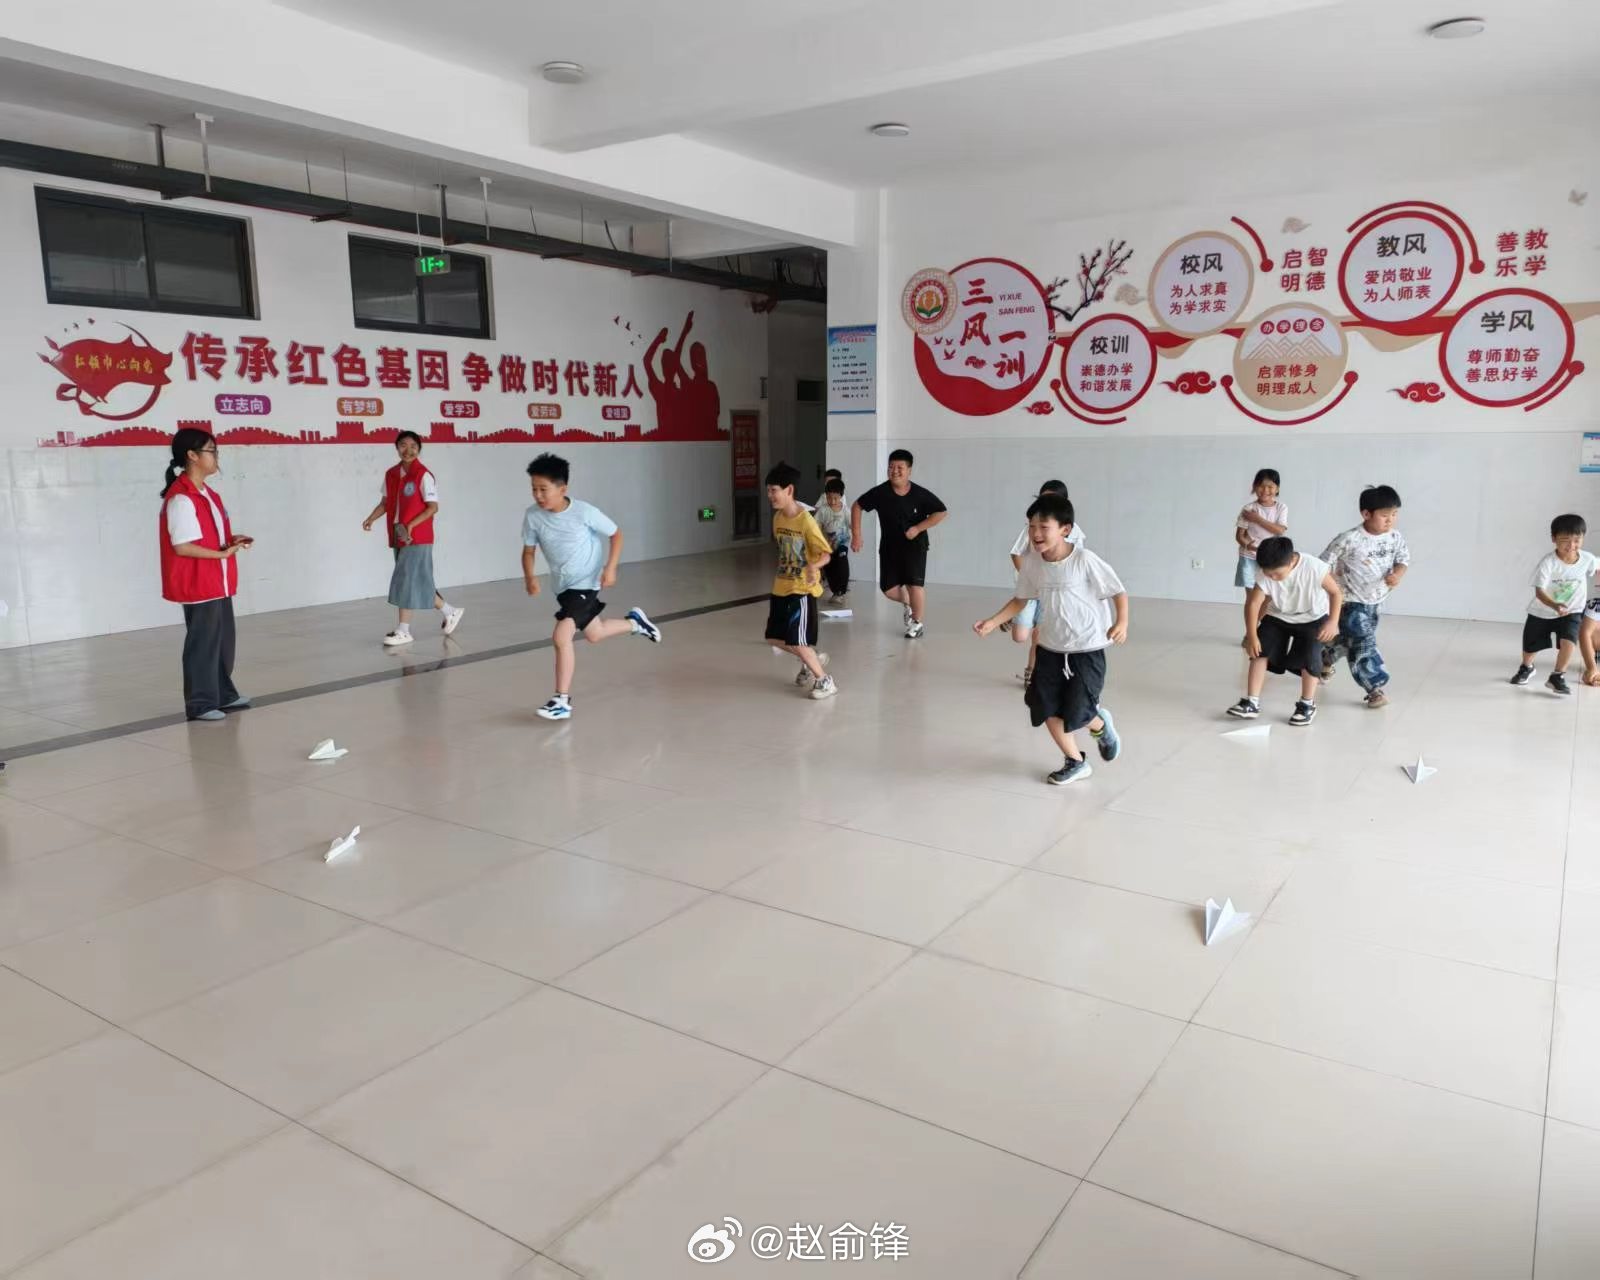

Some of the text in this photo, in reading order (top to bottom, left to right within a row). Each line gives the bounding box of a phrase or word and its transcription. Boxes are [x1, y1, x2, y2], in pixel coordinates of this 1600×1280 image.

[1377, 233, 1427, 257] 教风
[1497, 229, 1549, 252] 善教
[420, 257, 435, 273] 1F
[1180, 253, 1223, 274] 校风
[1282, 248, 1328, 269] 启智
[1495, 255, 1548, 277] 乐学
[1280, 272, 1327, 293] 明德
[1364, 266, 1432, 286] 爱岗敬业
[1170, 282, 1227, 298] 为人求真
[1363, 285, 1432, 303] 为人师表
[960, 278, 993, 346] 三风
[1169, 299, 1226, 315] 为学求实
[1261, 319, 1323, 334] 办学理念
[1480, 309, 1535, 333] 学风
[1090, 335, 1129, 355] 校训
[993, 330, 1027, 382] 一训
[1467, 349, 1540, 364] 尊师勤奋
[180, 331, 643, 399] 传承红色基因 争做时代新人
[1080, 363, 1133, 378] 崇德办学
[1257, 364, 1319, 379] 启蒙修身
[1466, 367, 1538, 383] 善思好学
[1079, 378, 1132, 393] 和谐发展
[1256, 382, 1318, 396] 明理成人
[219, 397, 264, 414] 立志向
[341, 400, 378, 415] 有梦想
[444, 403, 475, 417] 爱学习
